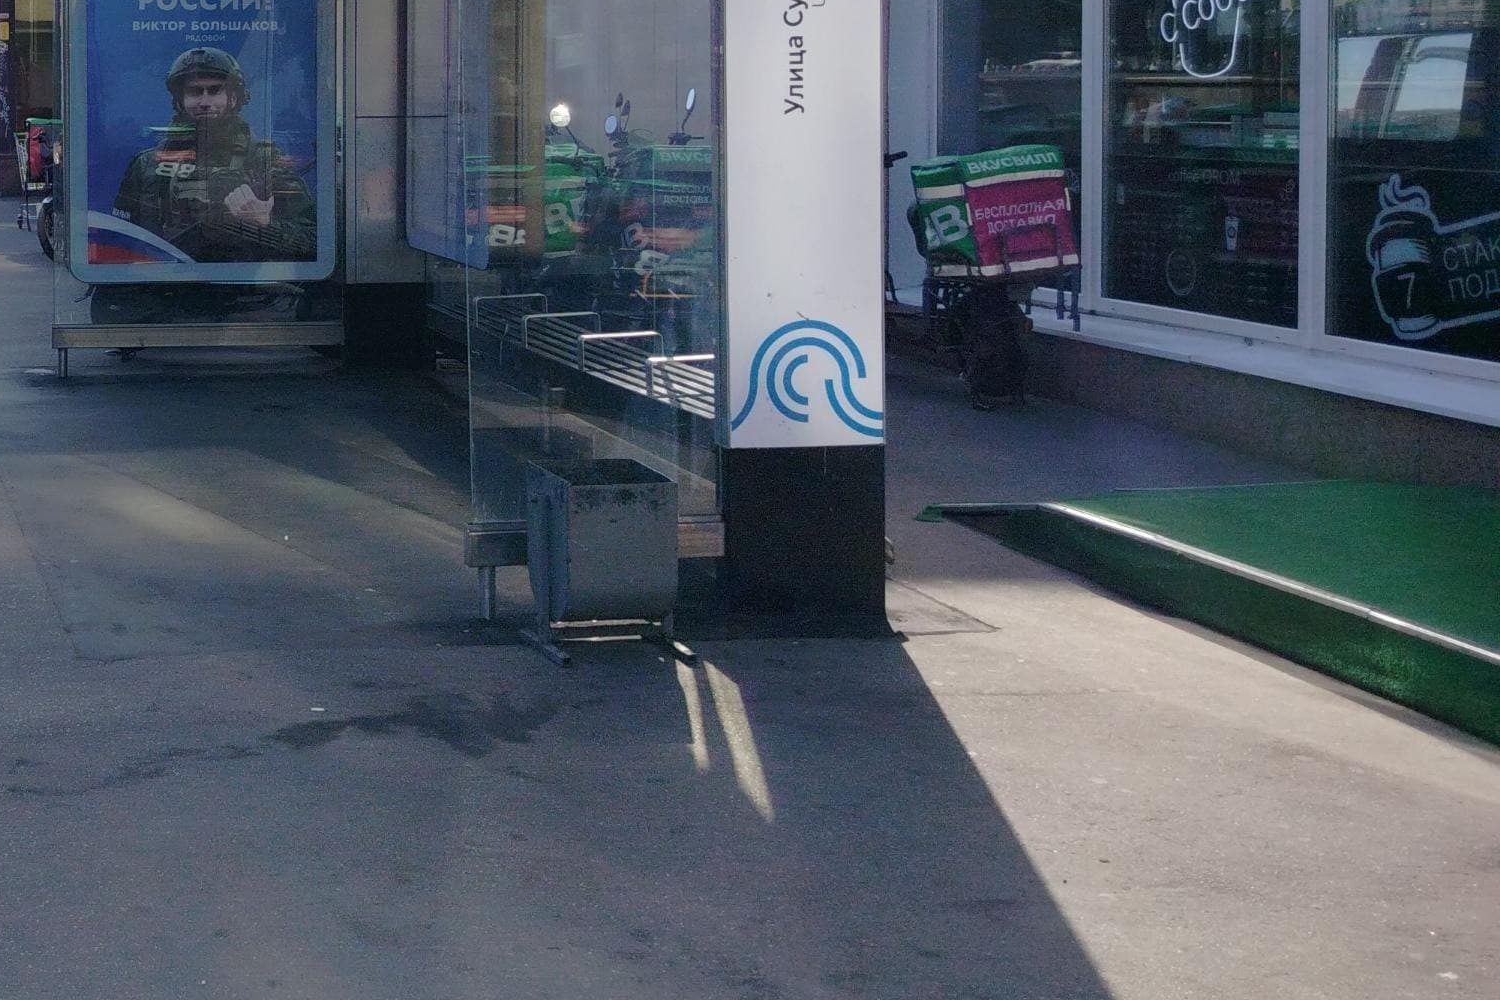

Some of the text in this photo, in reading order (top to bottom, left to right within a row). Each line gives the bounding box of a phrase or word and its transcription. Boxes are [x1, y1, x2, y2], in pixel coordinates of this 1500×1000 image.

[132, 20, 278, 31] ВИКТОР БОЛЬШАКОВ
[185, 33, 227, 42] РЯДОВОЙ
[784, 35, 807, 114] Улица
